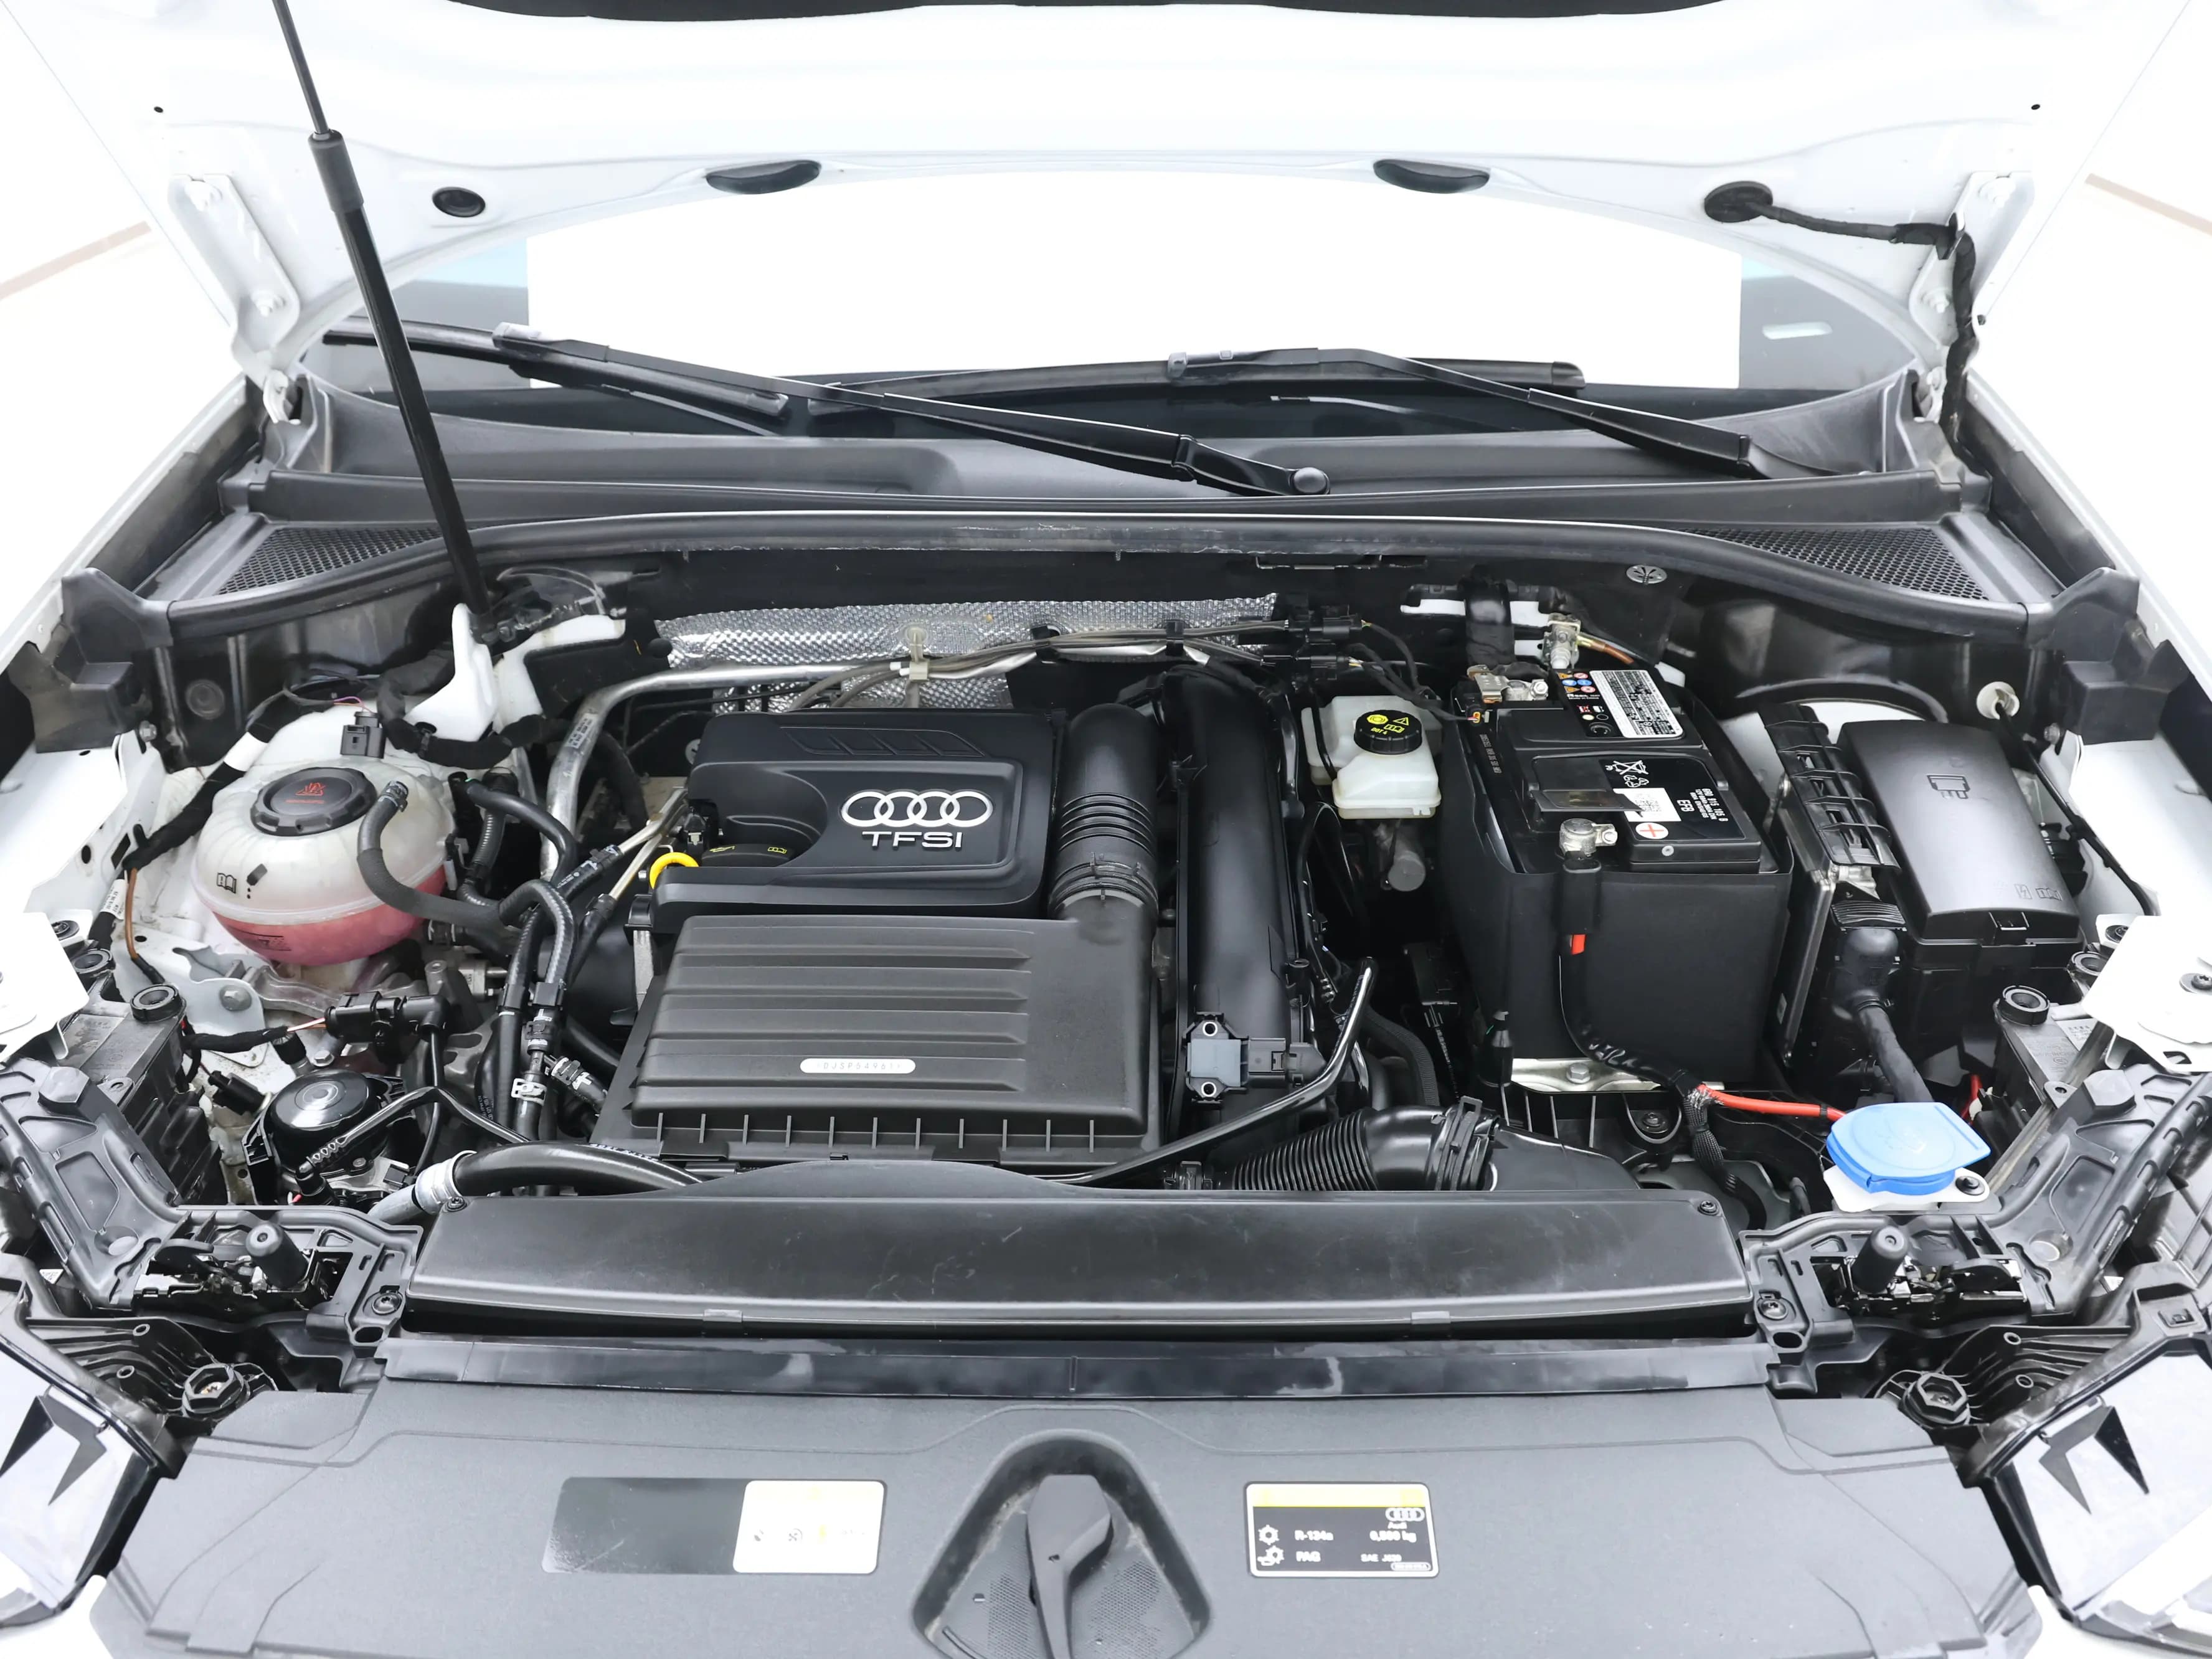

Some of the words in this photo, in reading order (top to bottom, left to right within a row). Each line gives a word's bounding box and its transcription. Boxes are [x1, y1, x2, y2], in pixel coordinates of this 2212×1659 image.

[1676, 800, 1694, 812] EFB
[1707, 798, 1719, 806] 915
[1713, 808, 1725, 816] 105
[862, 831, 963, 848] TFSI
[1295, 1530, 1333, 1540] R-134a
[1402, 1531, 1417, 1543] kg
[1296, 1551, 1321, 1562] PAG
[1361, 1554, 1378, 1562] SAE
